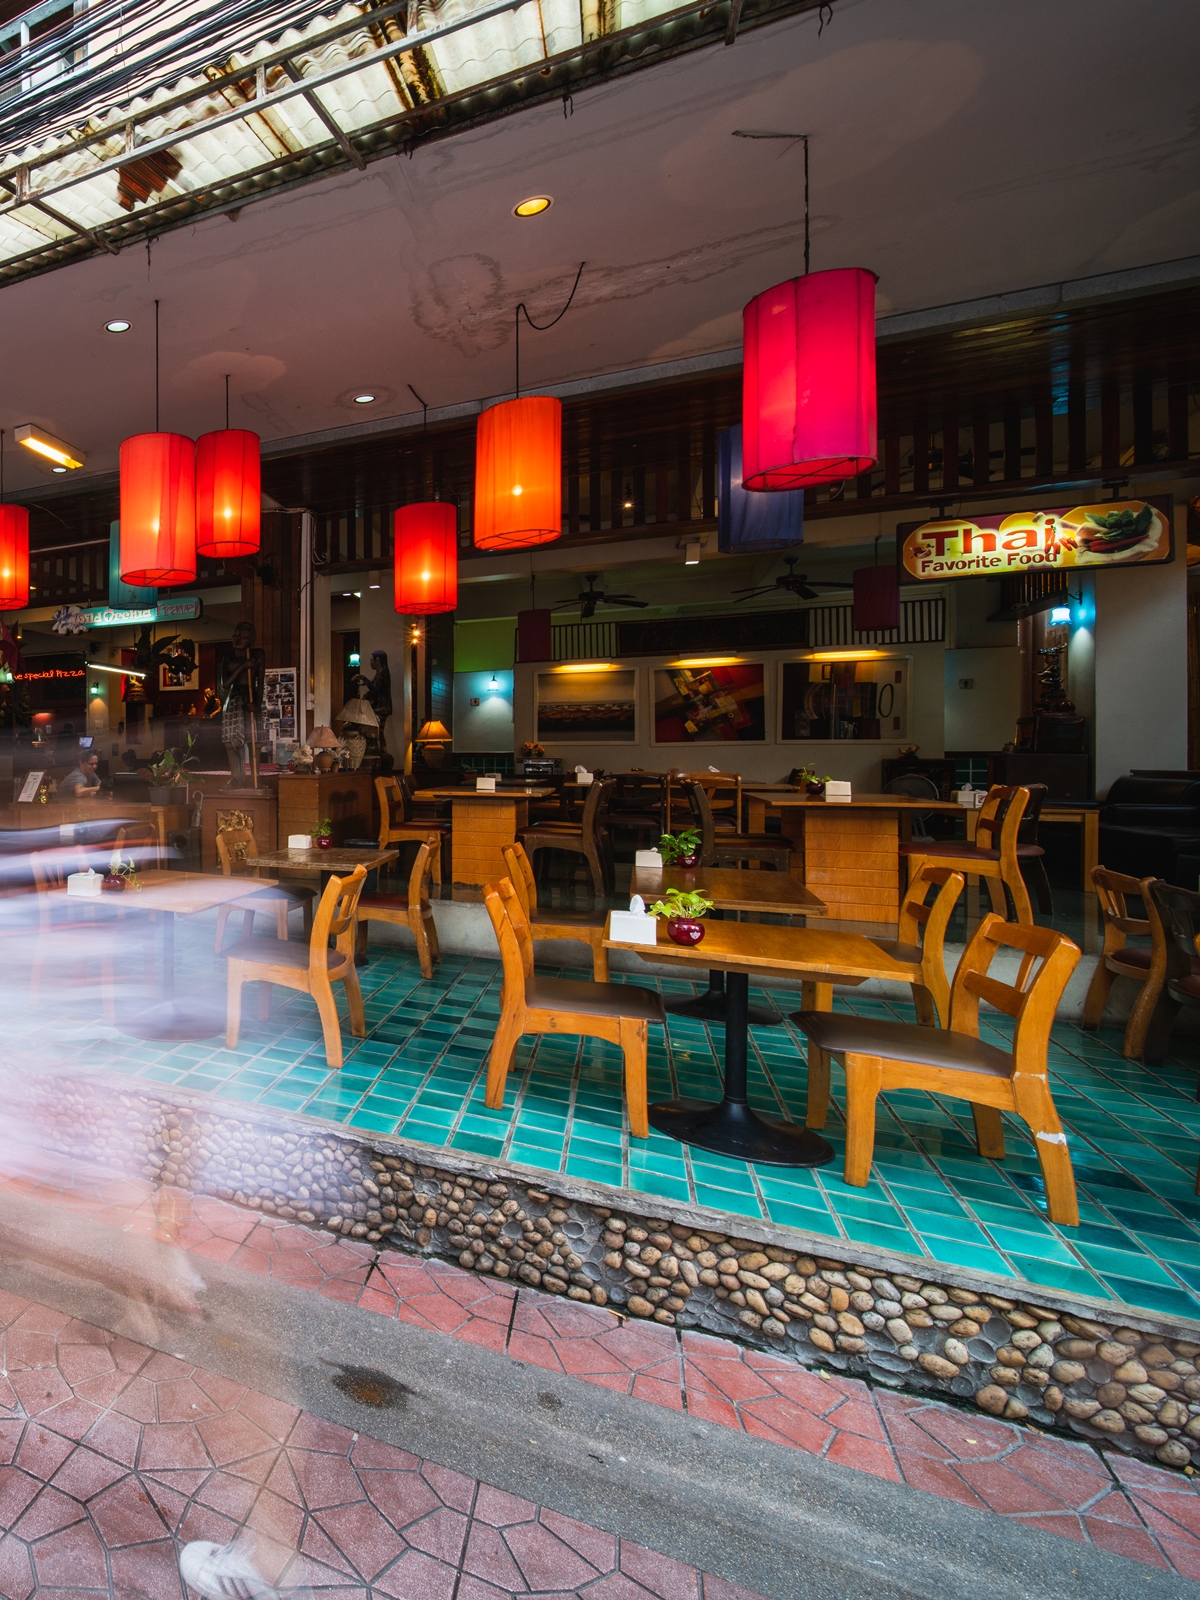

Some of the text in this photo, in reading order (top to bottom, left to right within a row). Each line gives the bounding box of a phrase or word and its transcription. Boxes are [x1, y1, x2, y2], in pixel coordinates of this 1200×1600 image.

[921, 517, 1057, 557] Thai
[921, 551, 1058, 573] Favorite Food
[104, 608, 152, 622] Orchid
[156, 600, 200, 617] Travel
[24, 669, 55, 682] special
